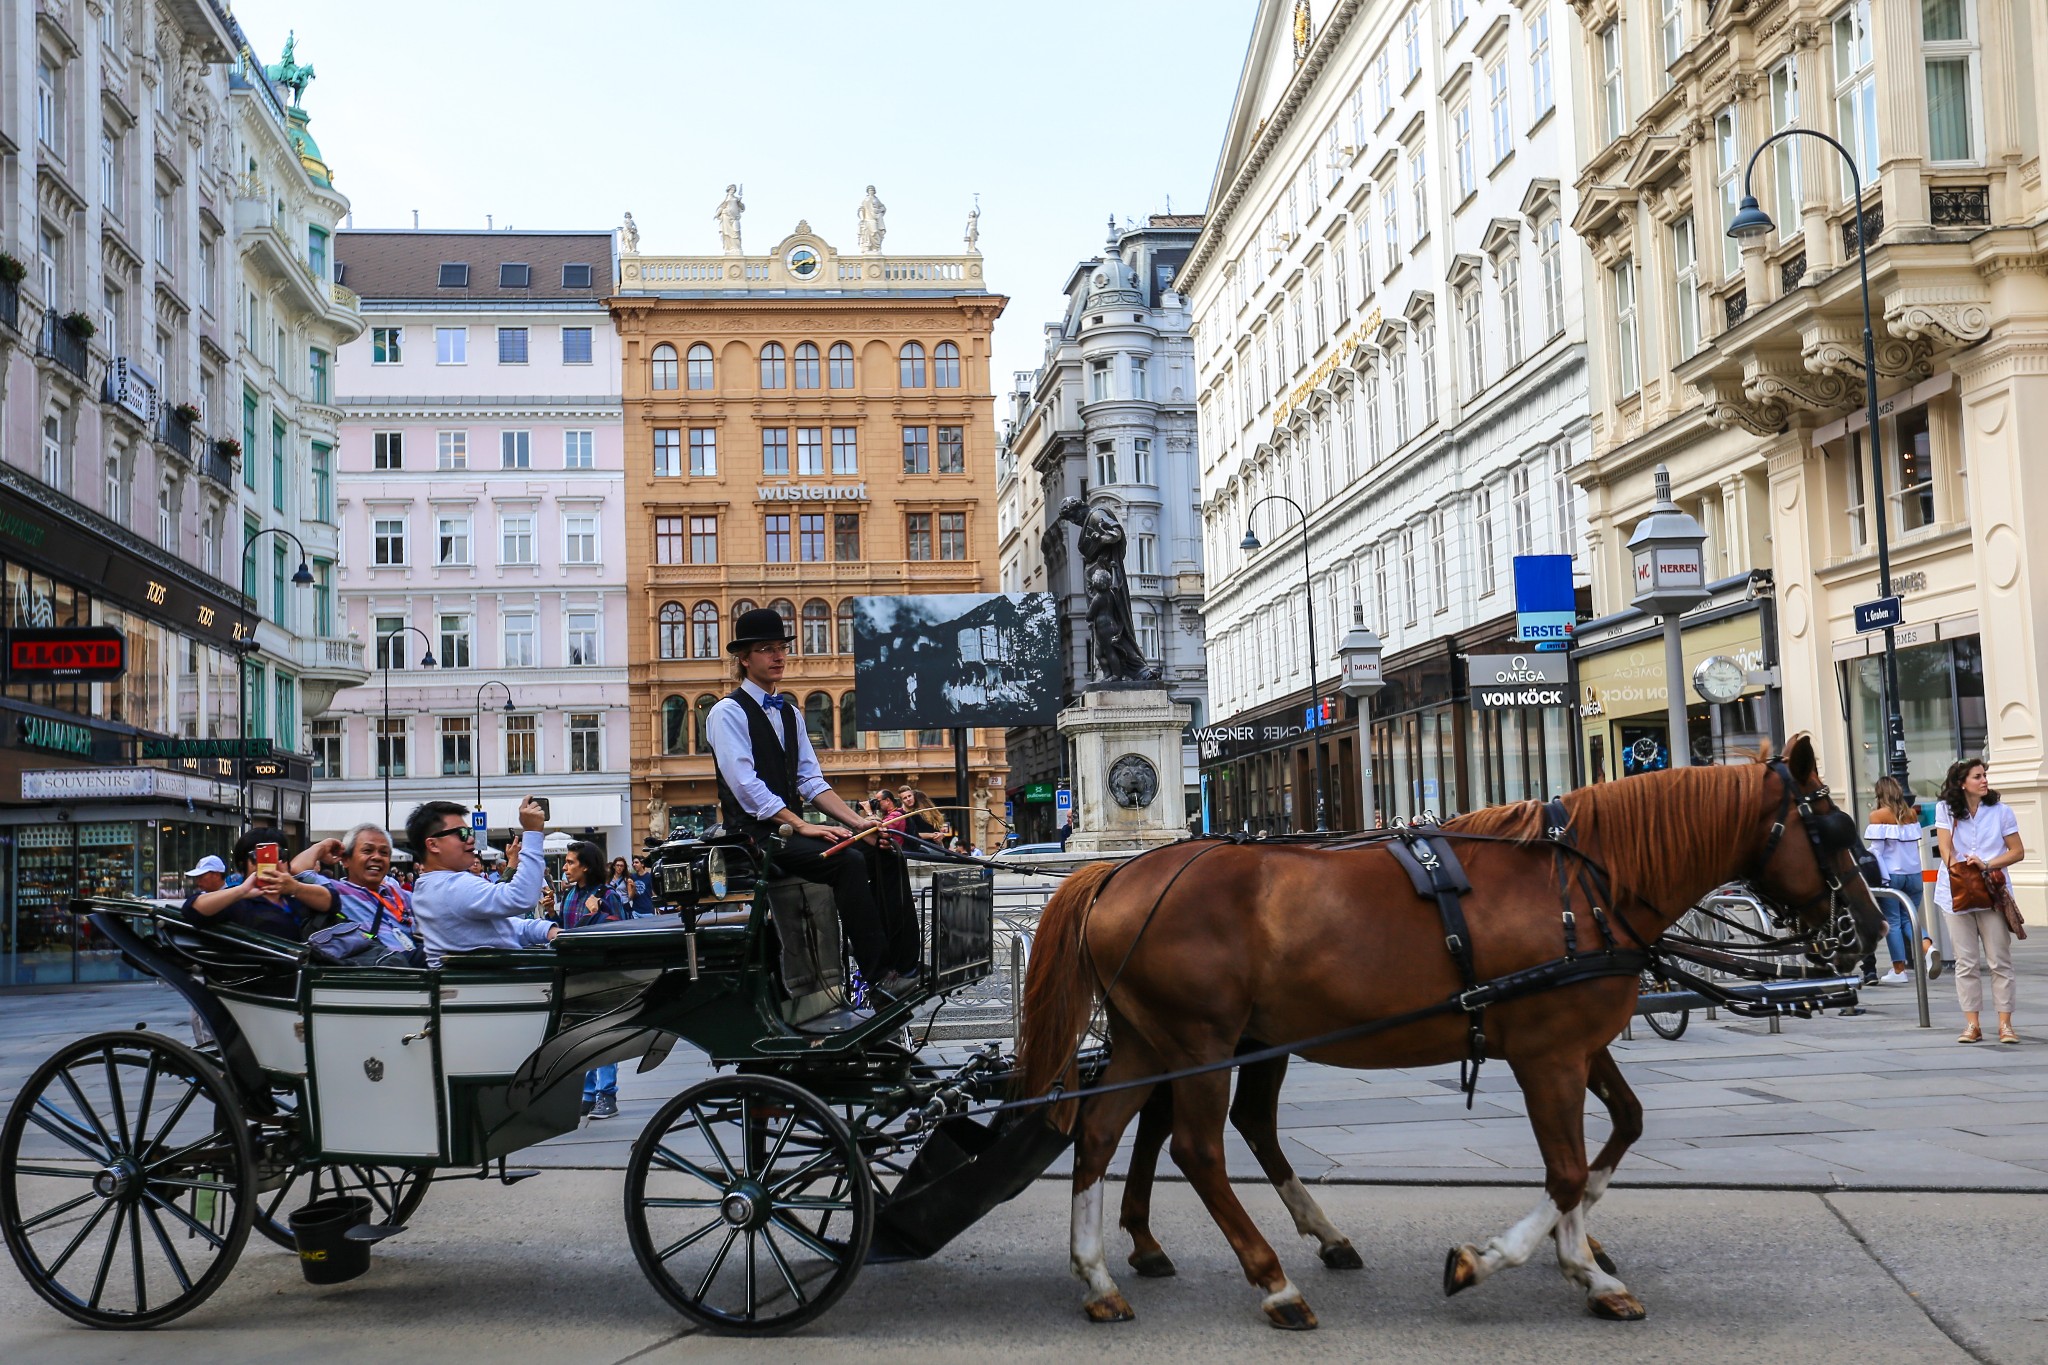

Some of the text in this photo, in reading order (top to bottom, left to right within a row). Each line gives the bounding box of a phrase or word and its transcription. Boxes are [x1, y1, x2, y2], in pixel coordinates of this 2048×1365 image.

[117, 356, 128, 401] PENSION
[130, 381, 145, 399] NSION
[1638, 563, 1651, 580] WC
[1660, 564, 1698, 574] HERREN
[1870, 608, 1889, 621] Graben
[1523, 625, 1563, 638] ERSTE
[17, 645, 117, 665] LLOYD
[1731, 647, 1764, 671] ÖCK
[1495, 670, 1546, 683] OMEGA
[1482, 688, 1562, 707] VON KÖCK
[1579, 704, 1603, 718] OMEGA
[24, 714, 92, 757] SALAMANDER
[1191, 726, 1255, 742] WAGNER
[255, 765, 277, 774] TOD'S
[44, 775, 131, 789] SOUVENIRS
